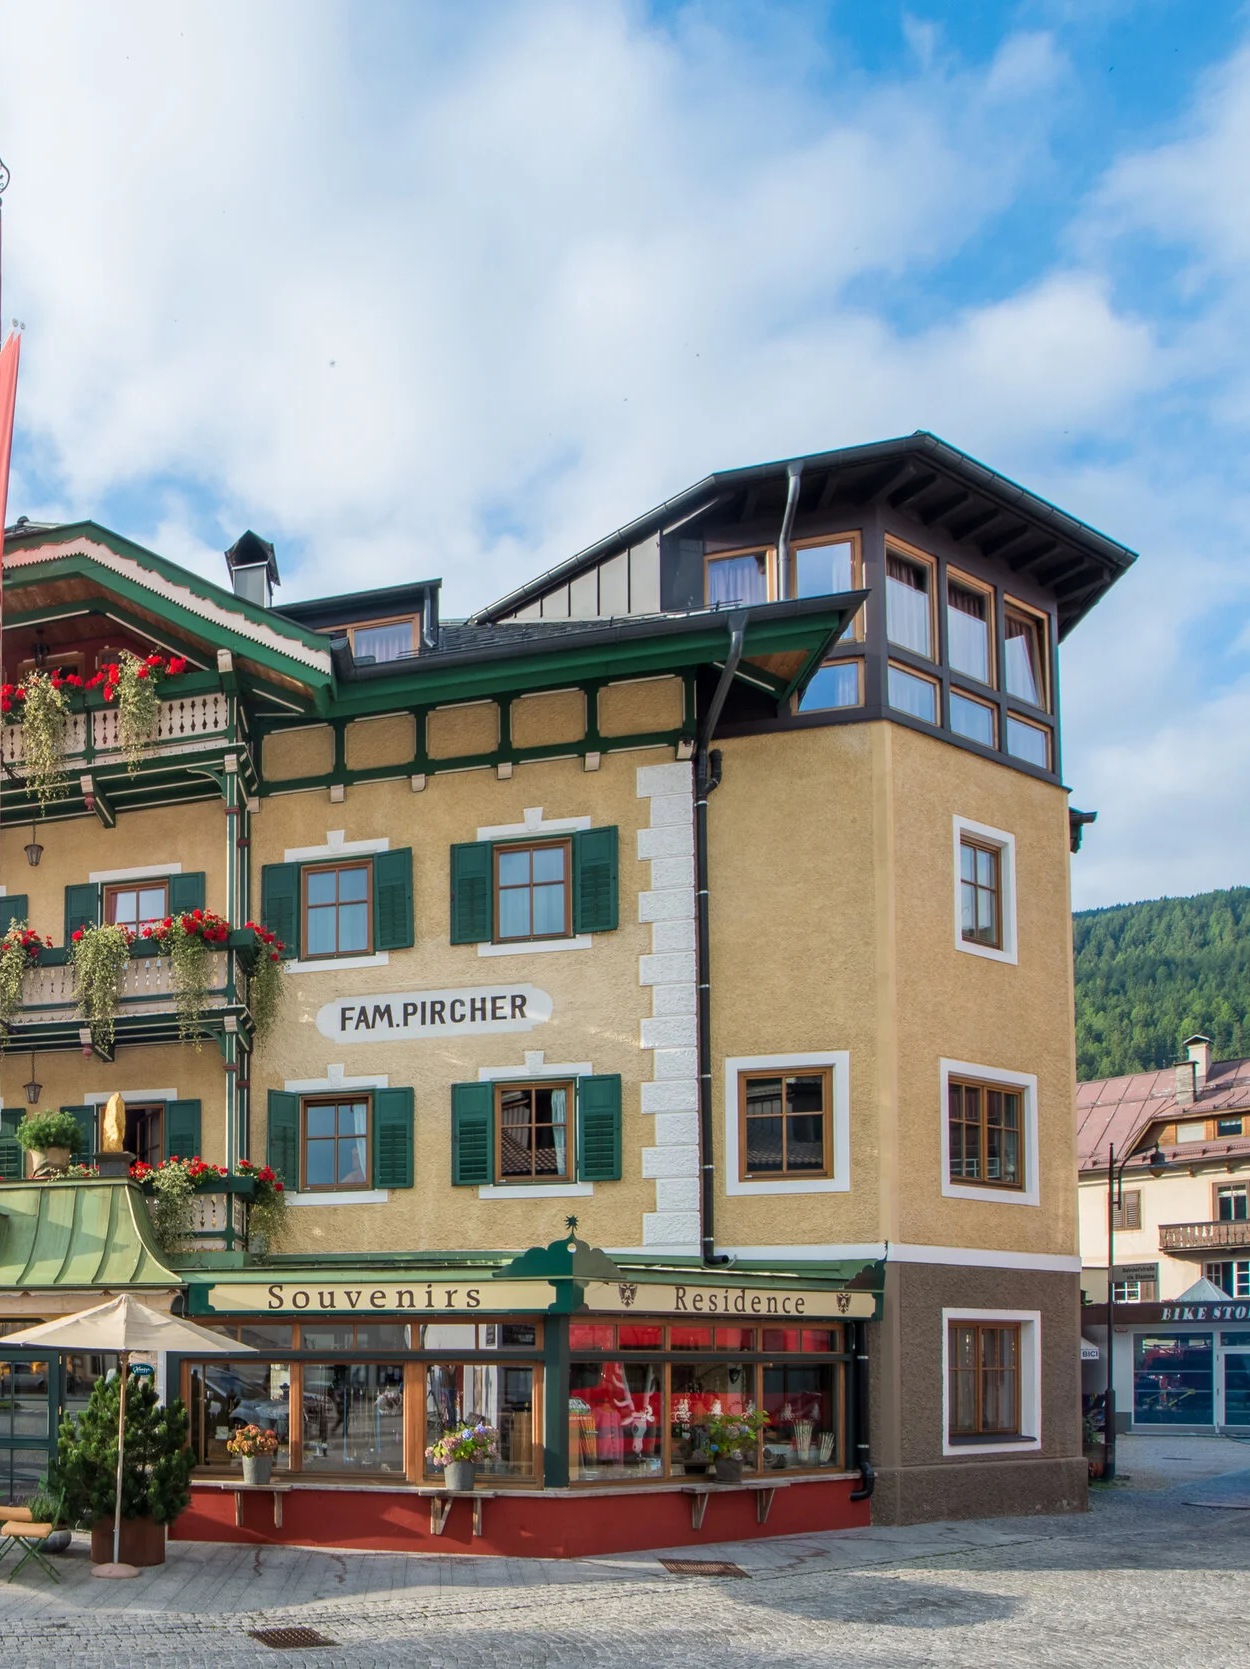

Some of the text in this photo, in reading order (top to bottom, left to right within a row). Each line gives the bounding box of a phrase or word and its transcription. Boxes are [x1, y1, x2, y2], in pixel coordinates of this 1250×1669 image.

[267, 1283, 481, 1309] Souvenirs
[674, 1286, 806, 1314] Residence
[1161, 1305, 1250, 1321] BIKE STO
[1082, 1350, 1098, 1358] BICI
